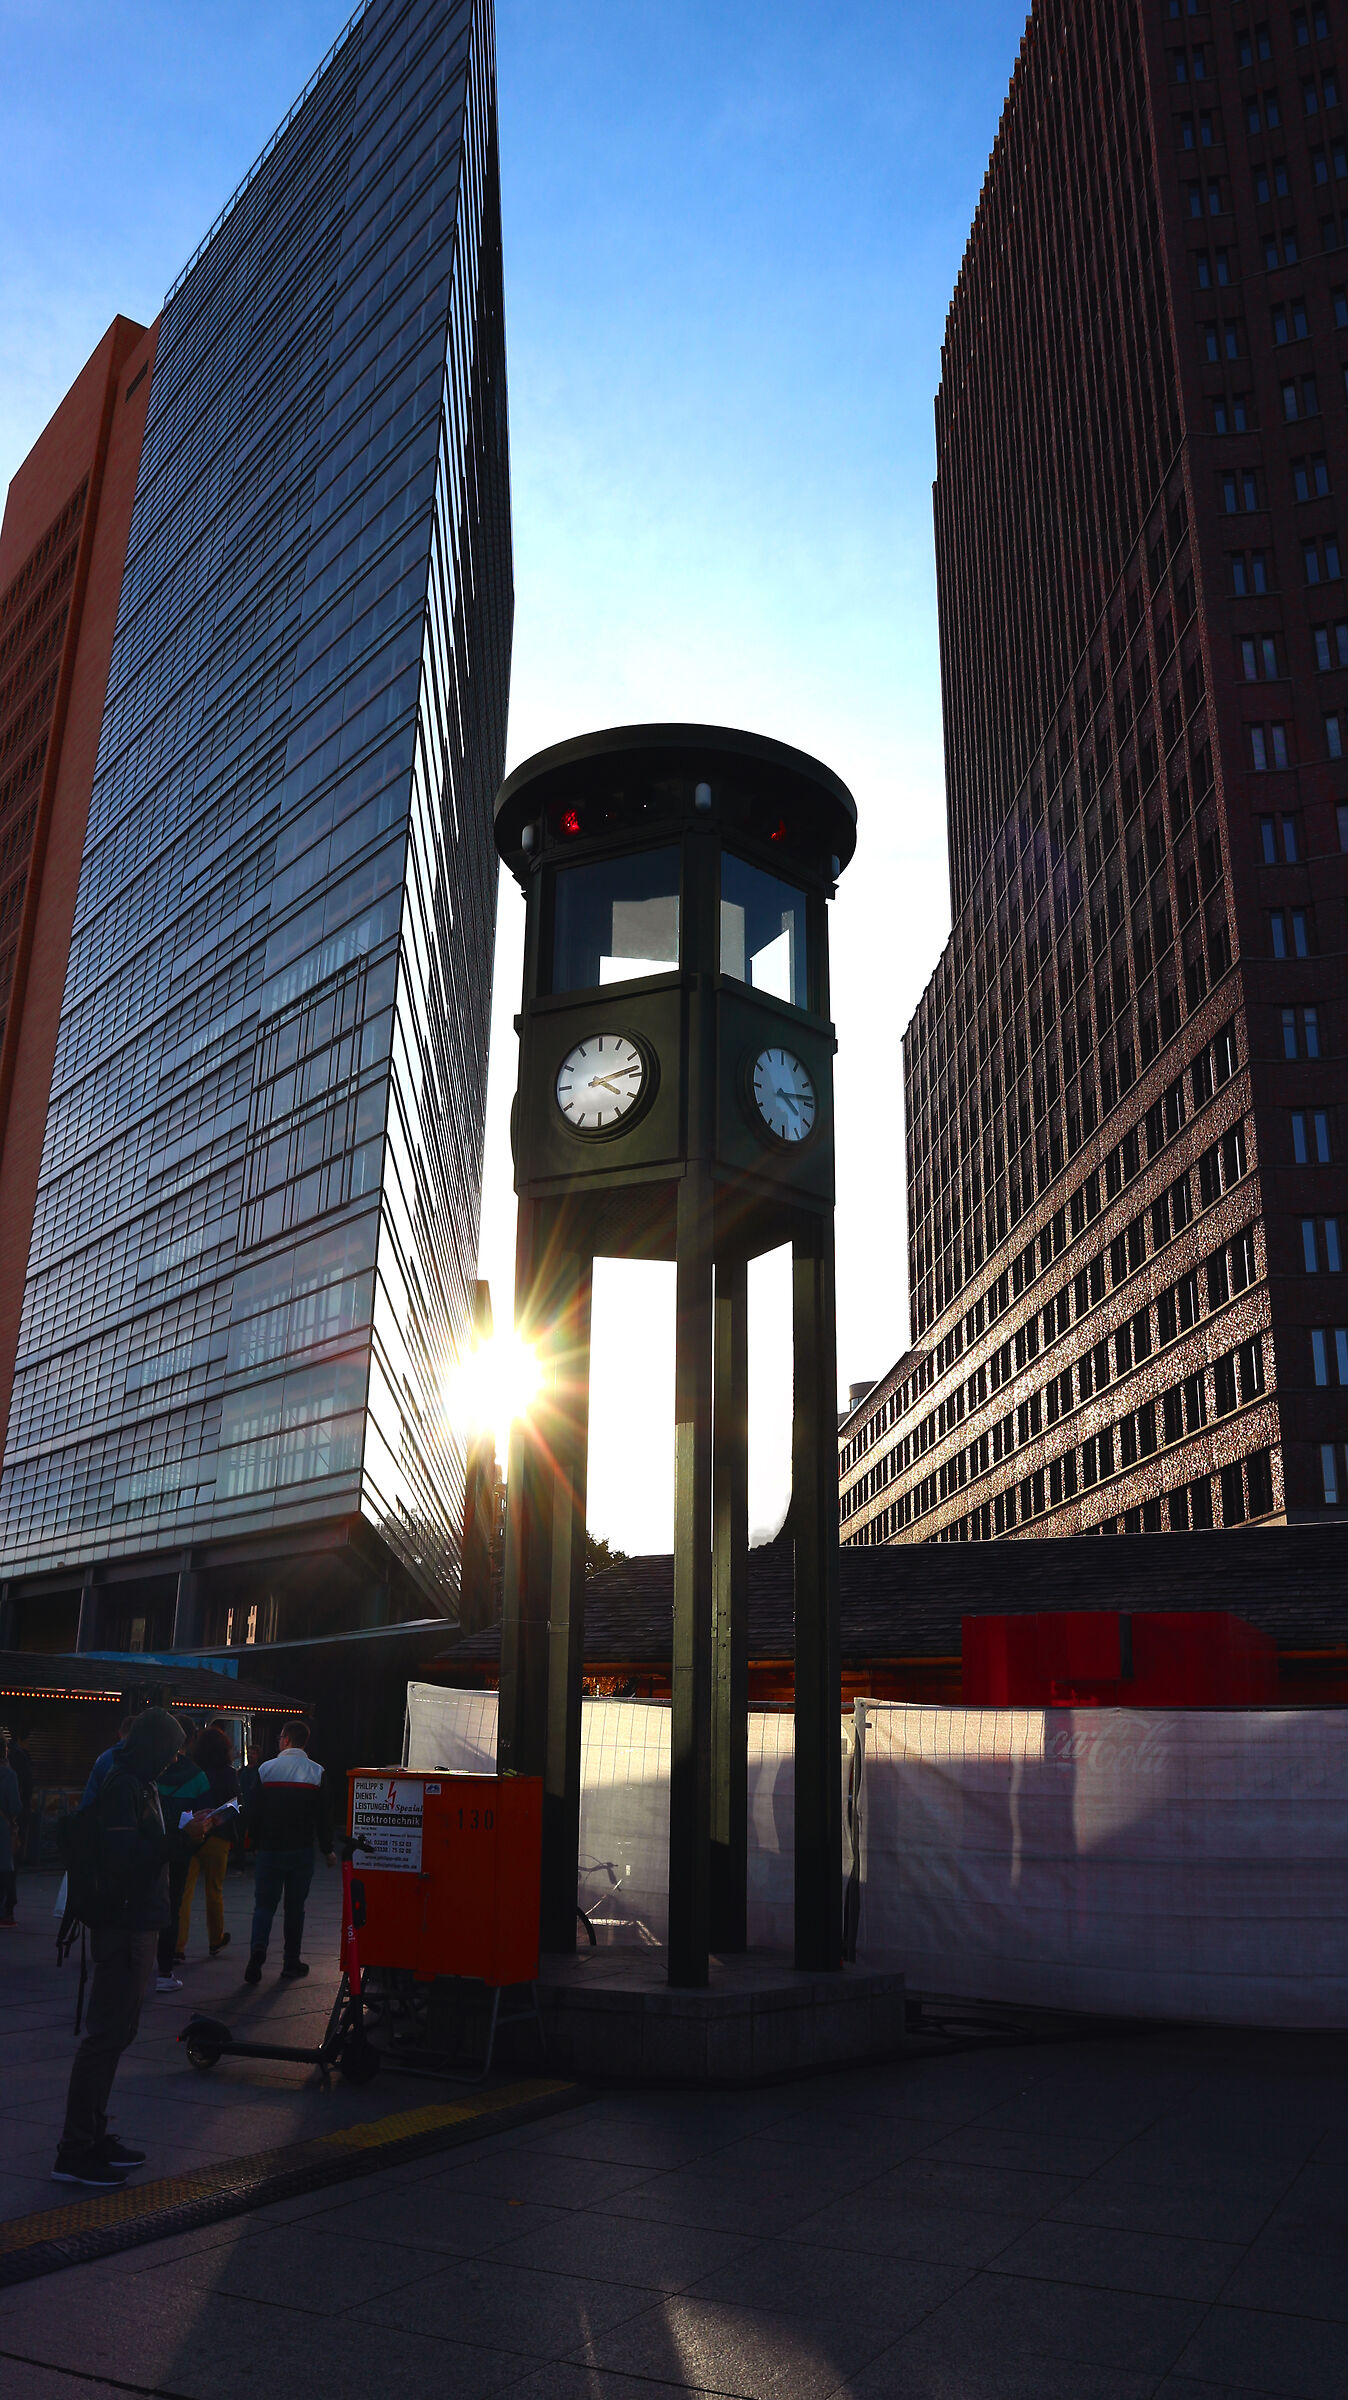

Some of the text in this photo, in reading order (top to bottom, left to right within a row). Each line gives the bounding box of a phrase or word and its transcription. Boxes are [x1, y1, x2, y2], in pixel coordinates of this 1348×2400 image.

[355, 1792, 377, 1800] DIENST-
[355, 1802, 390, 1811] LEISTUNGEN
[395, 1804, 423, 1813] Spezial
[357, 1814, 420, 1825] Elektrotechnik
[458, 1809, 494, 1831] 130
